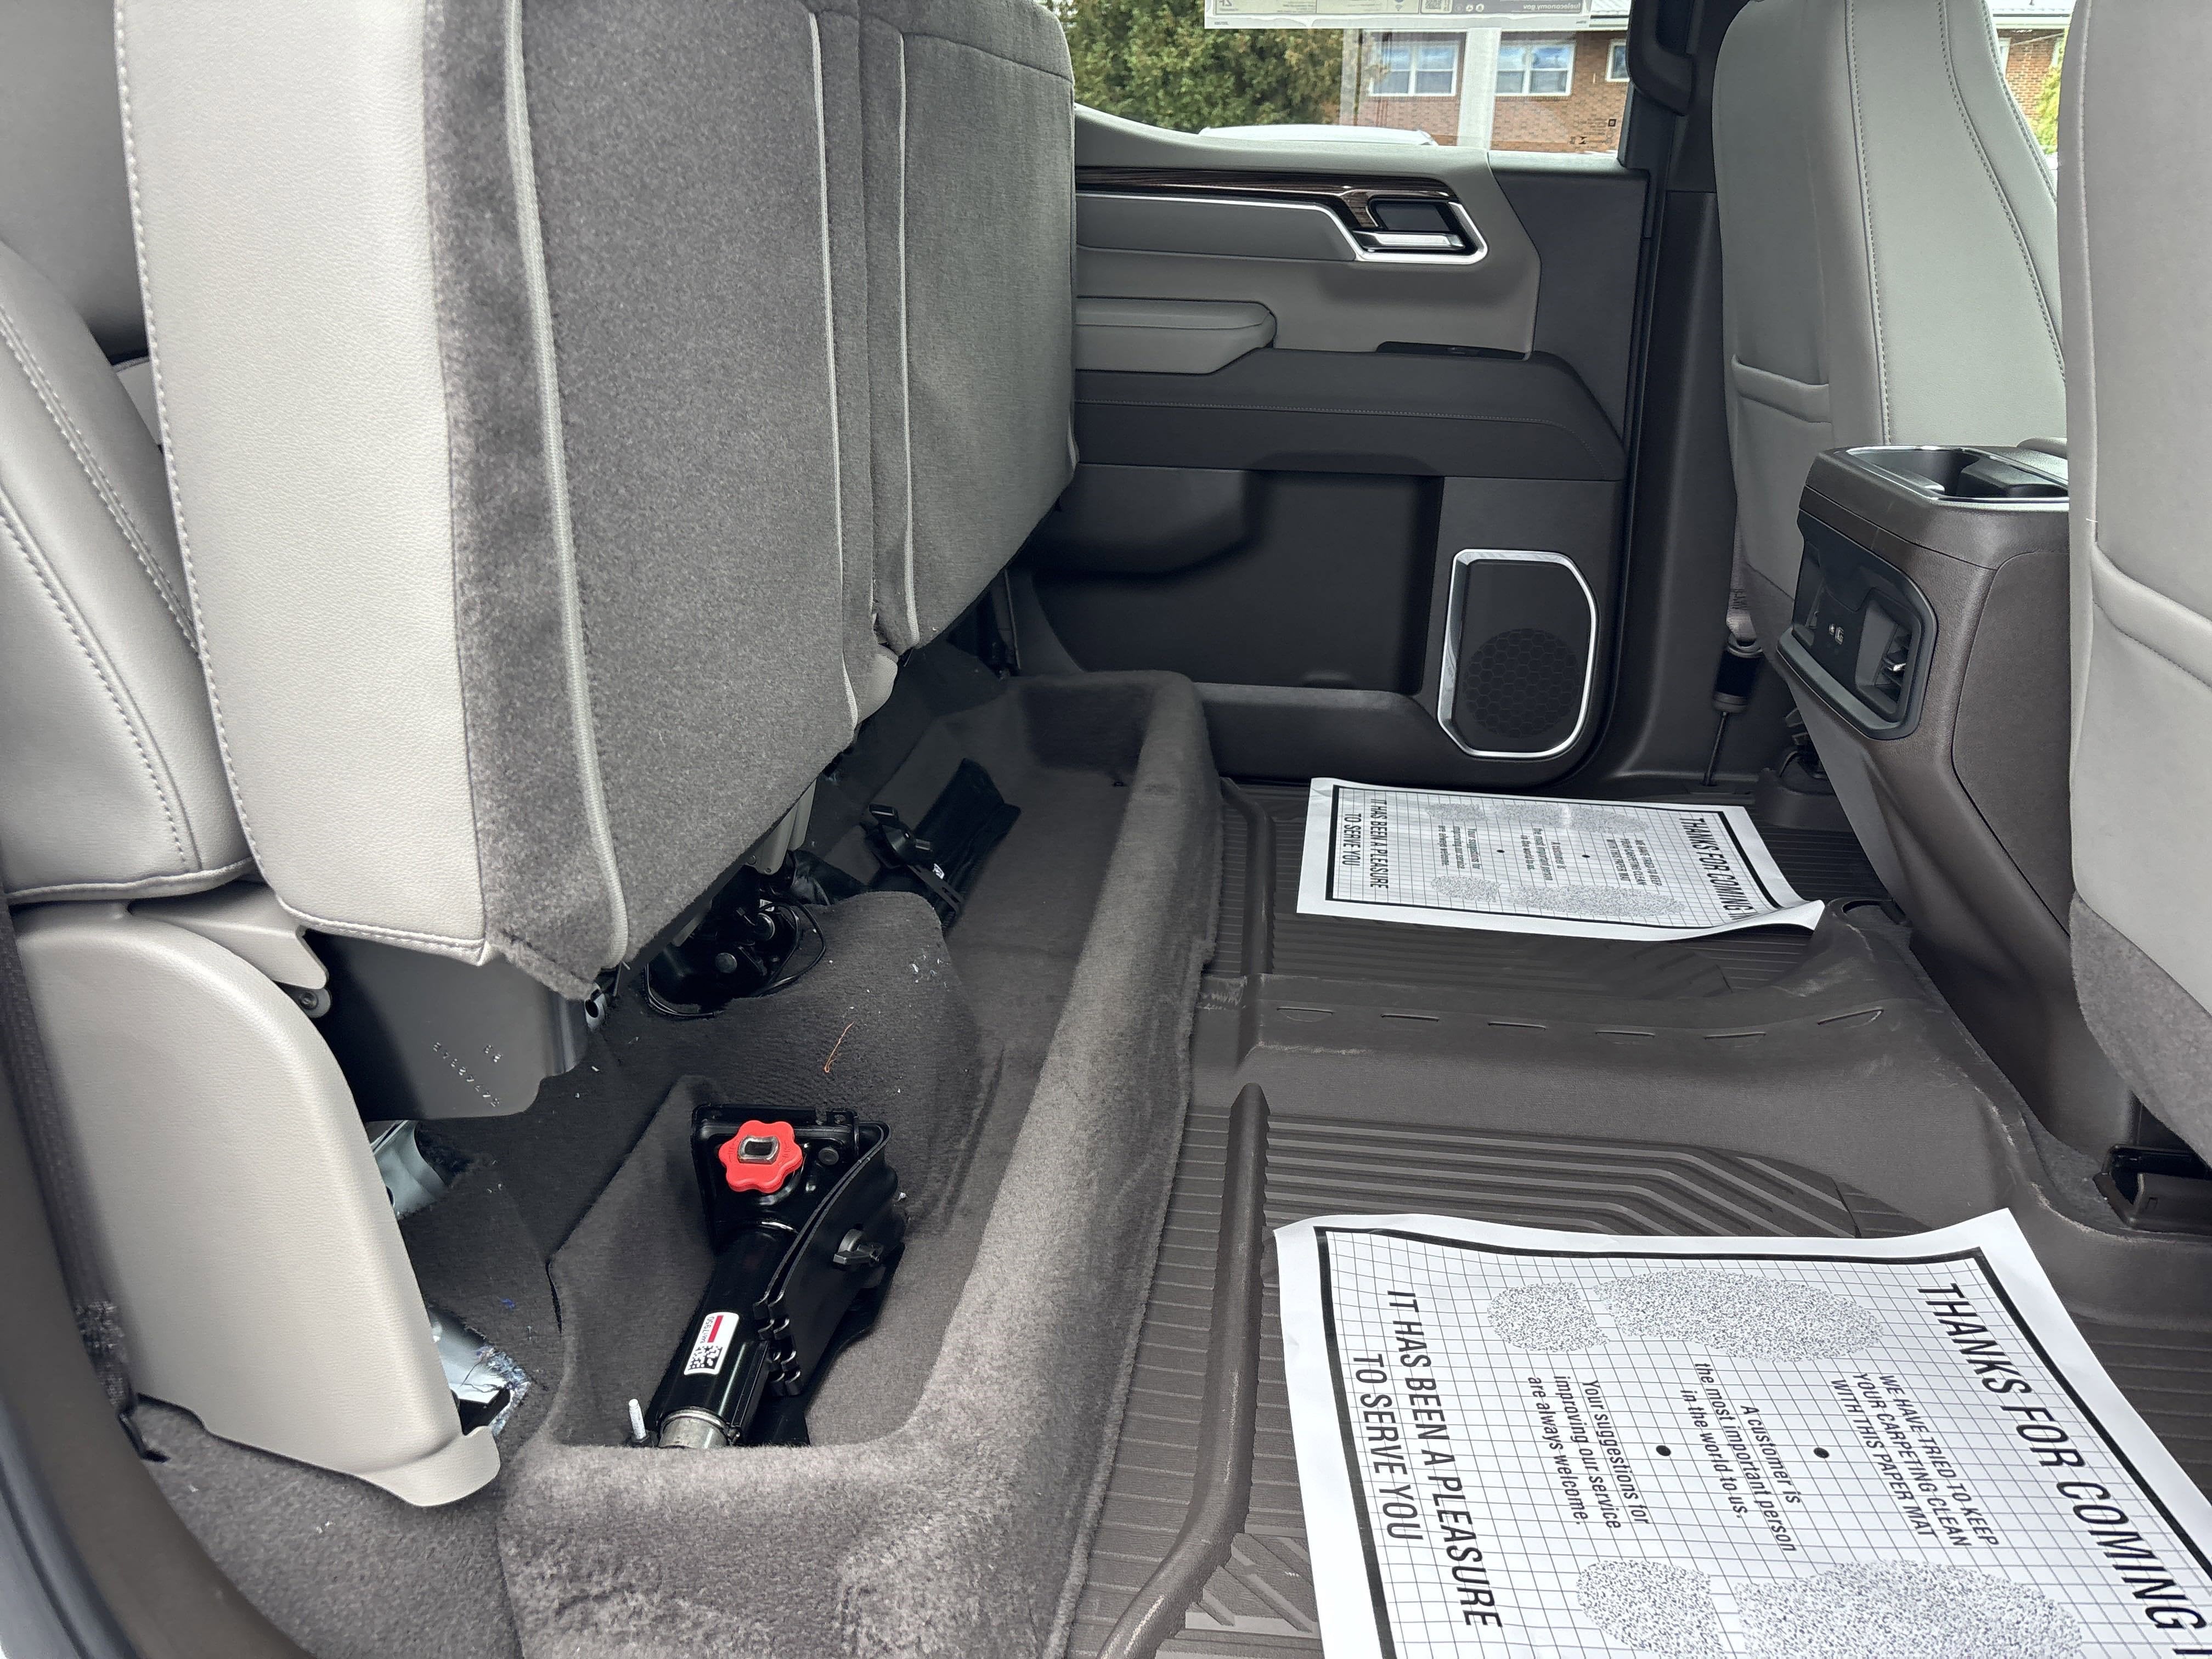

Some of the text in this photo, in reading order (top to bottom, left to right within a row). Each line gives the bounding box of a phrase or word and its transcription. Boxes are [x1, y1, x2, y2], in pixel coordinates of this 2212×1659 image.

[1342, 813, 1361, 866] TO SERVE YOU
[1370, 805, 1387, 819] HAS
[1370, 821, 1387, 840] BEEN
[1370, 848, 1389, 889] PLEASURE
[1679, 818, 1719, 850] THANKS
[1696, 852, 1730, 871] FOR
[1707, 873, 1754, 910] COMING
[1353, 1353, 1424, 1540] TO SERVE YOU
[1387, 1290, 1503, 1627] IT HAS BEEN A PLEASURE
[1528, 1377, 1588, 1525] are always welcome.
[1554, 1376, 1621, 1528] improving our service
[1583, 1380, 1650, 1524] Your suggestions for
[1680, 1390, 1747, 1518] in the world to us.
[1695, 1363, 1797, 1551] the most important person
[1740, 1405, 1801, 1503] A customer is
[1831, 1380, 1938, 1538] WITH THIS PAPER MAT
[1853, 1373, 1972, 1547] YOUR CARPETING CLEAN
[1879, 1375, 1999, 1545] WE HAVE TRIED TO KEEP
[1917, 1283, 2032, 1393] THANKS
[2000, 1406, 2085, 1467] FOR
[2057, 1481, 2207, 1629] COMING
